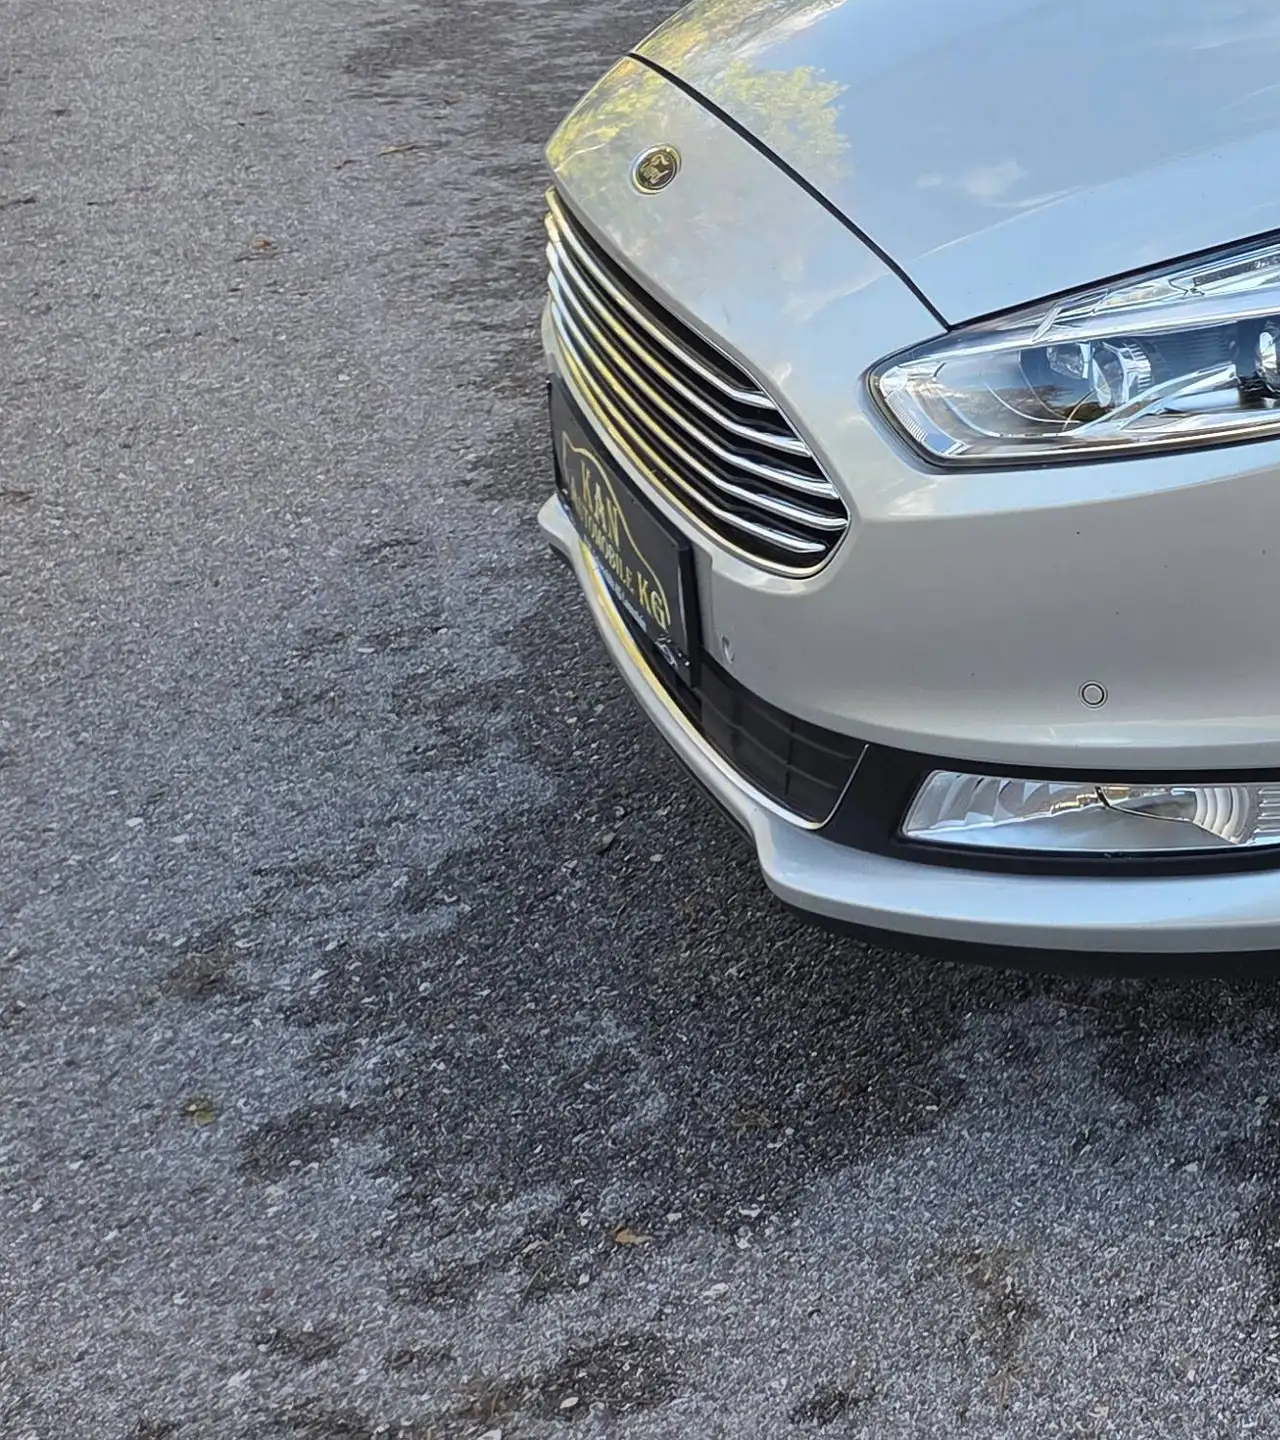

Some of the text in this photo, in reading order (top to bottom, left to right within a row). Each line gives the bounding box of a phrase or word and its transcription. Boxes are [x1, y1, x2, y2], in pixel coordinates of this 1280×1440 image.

[570, 475, 635, 594] AUTOMOBILE
[637, 570, 668, 633] KG
[580, 459, 620, 550] KAN
